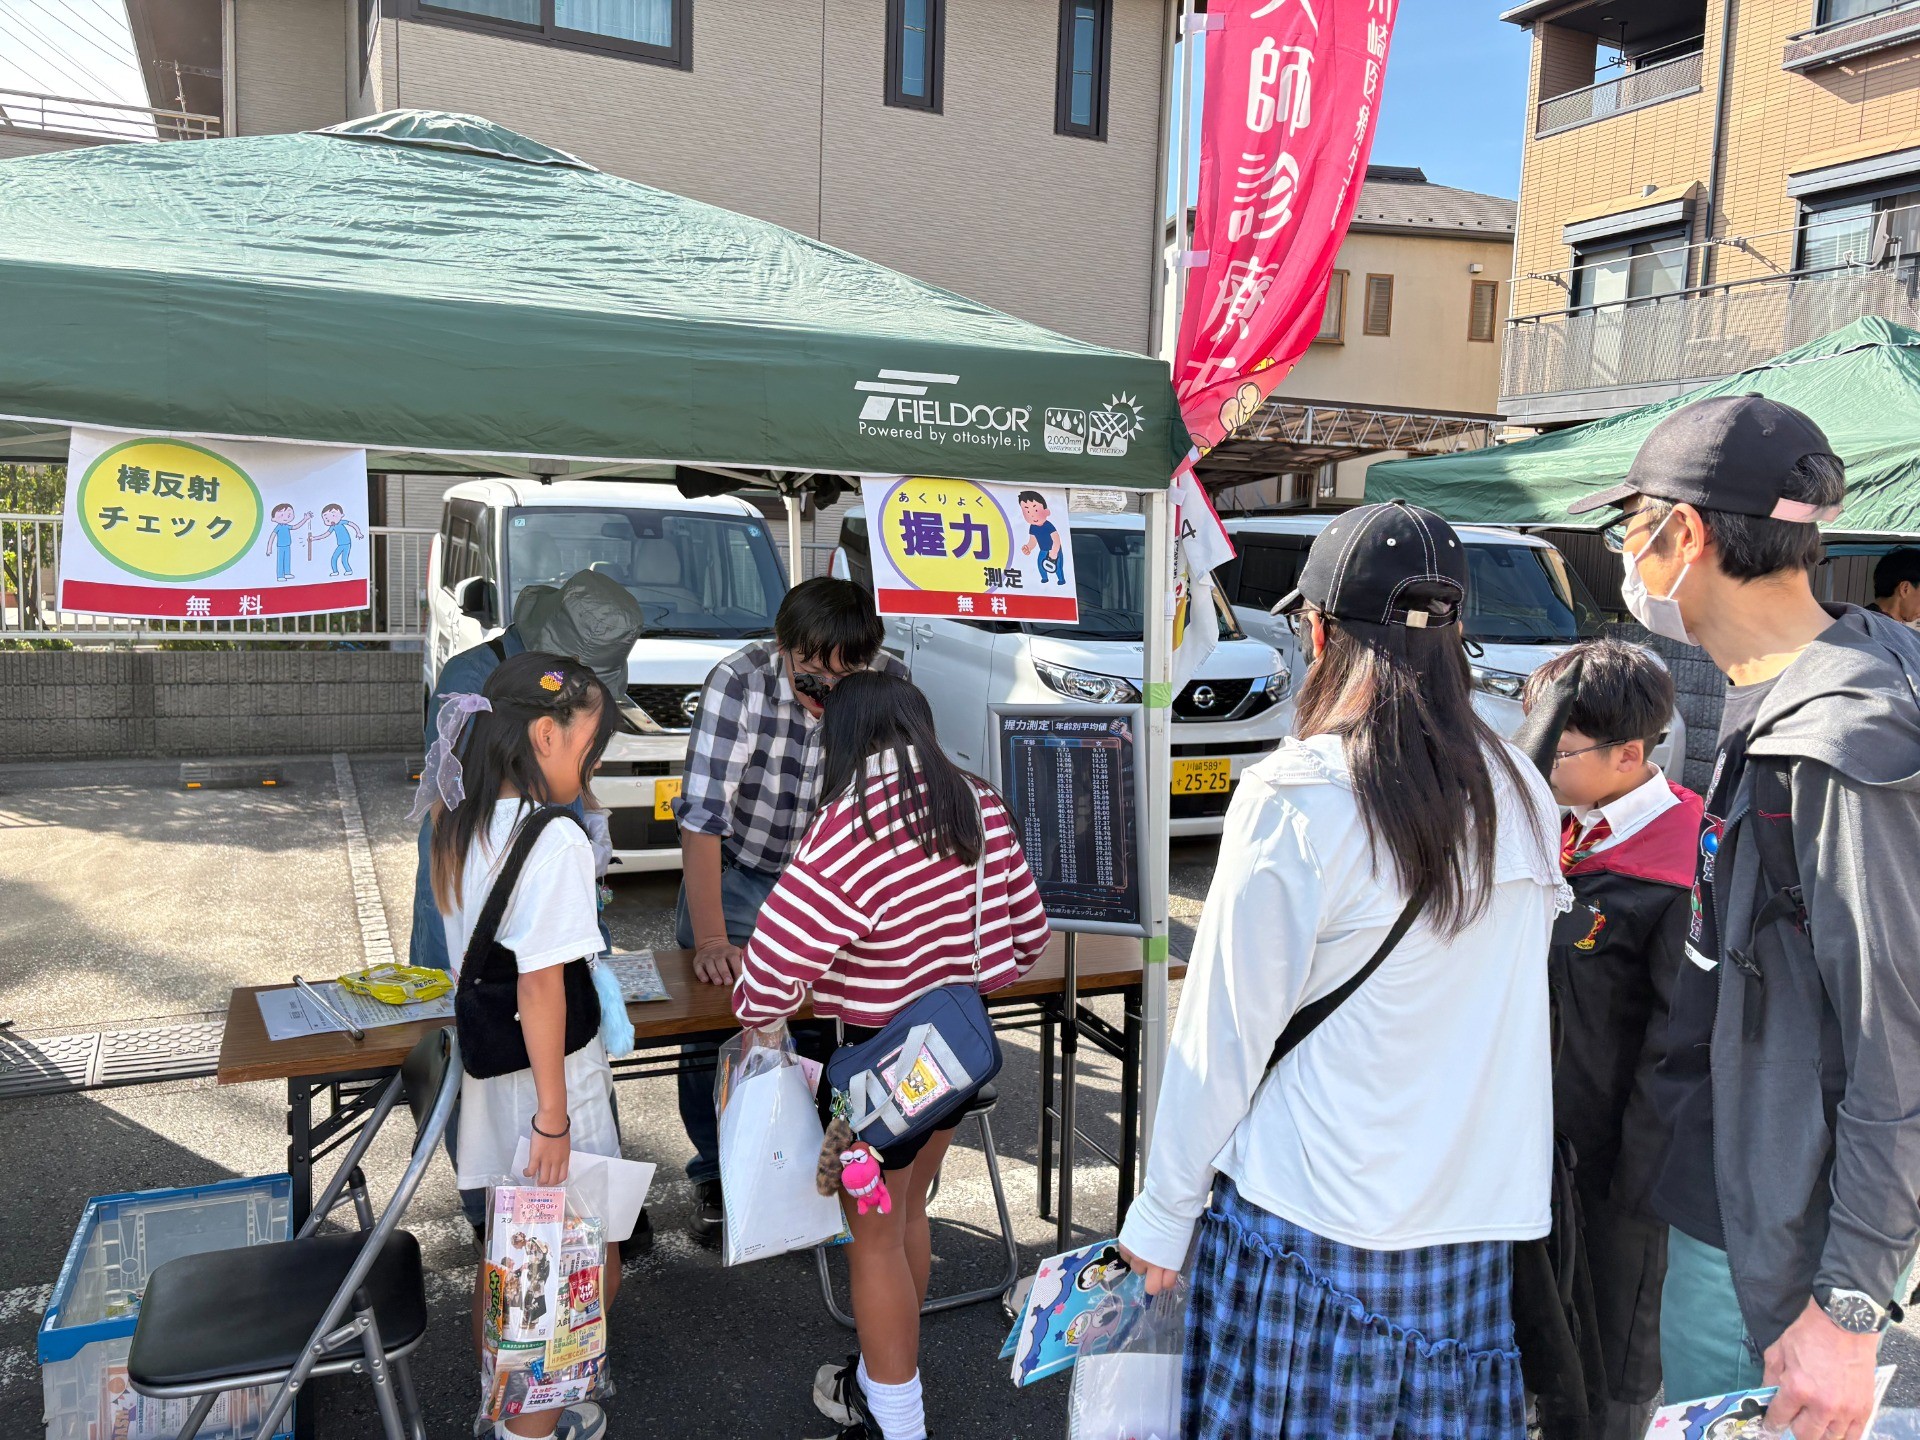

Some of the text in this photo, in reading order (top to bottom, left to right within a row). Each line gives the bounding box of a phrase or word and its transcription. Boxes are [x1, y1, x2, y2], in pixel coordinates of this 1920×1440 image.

[897, 398, 1029, 433] FIELDOOR
[859, 421, 1031, 451] Powered by ottostyle.jp
[1047, 435, 1082, 446] 2,000mm
[1091, 430, 1113, 448] UV
[116, 463, 220, 502] 棒反射
[898, 491, 984, 507] あくりょく
[98, 505, 233, 540] チェック
[898, 510, 991, 560] 握力
[983, 566, 1024, 589] 測定
[956, 595, 1008, 615] 無料
[1004, 719, 1108, 732] 握力測定 年齢別平均値
[1184, 773, 1227, 791] 25-25
[660, 801, 670, 812] る
